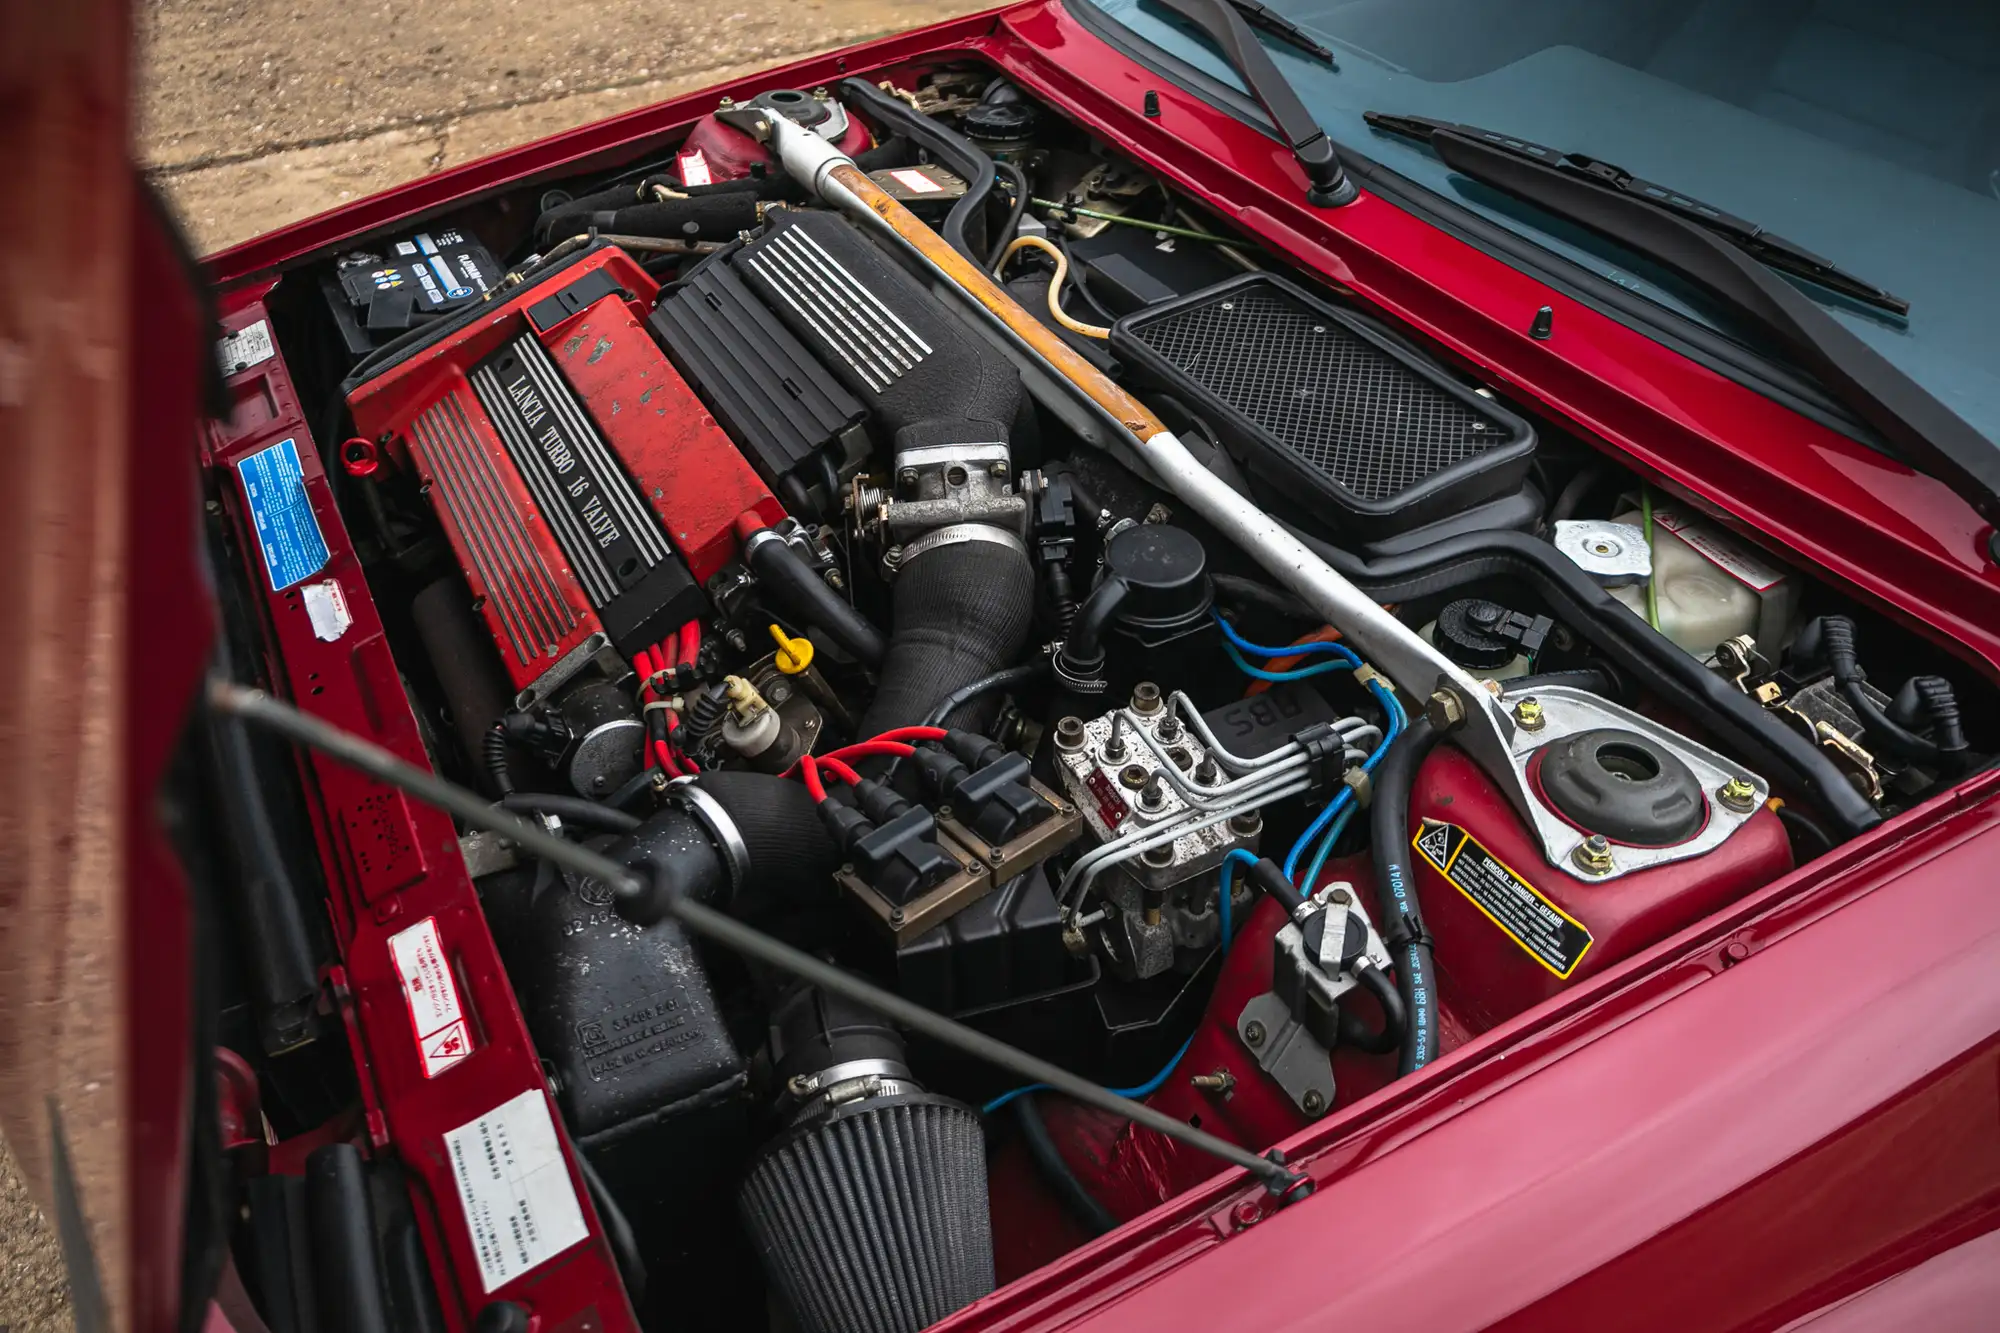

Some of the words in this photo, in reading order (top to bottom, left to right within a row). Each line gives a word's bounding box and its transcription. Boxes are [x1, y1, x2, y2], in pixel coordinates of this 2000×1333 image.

[458, 254, 482, 279] PLATINUM
[507, 375, 547, 429] LANCIA
[539, 425, 575, 474] TURBO
[567, 476, 590, 497] 16
[581, 495, 620, 548] VALVE
[1221, 688, 1303, 740] ABS
[1103, 784, 1122, 805] BOSCH
[1391, 872, 1406, 898] 07014
[1482, 857, 1509, 882] PERICOLO
[1510, 882, 1535, 904] DANGER
[1538, 905, 1564, 927] GEFAHR
[1464, 864, 1479, 878] SURFACES
[1490, 887, 1503, 899] EXPOSE
[1506, 900, 1515, 910] OPEN
[1514, 907, 1527, 920] FLAMES
[1528, 920, 1547, 937] CORROSIVE
[1413, 972, 1423, 984] SAE
[592, 1056, 622, 1076] MADE
[622, 1051, 635, 1065] IN
